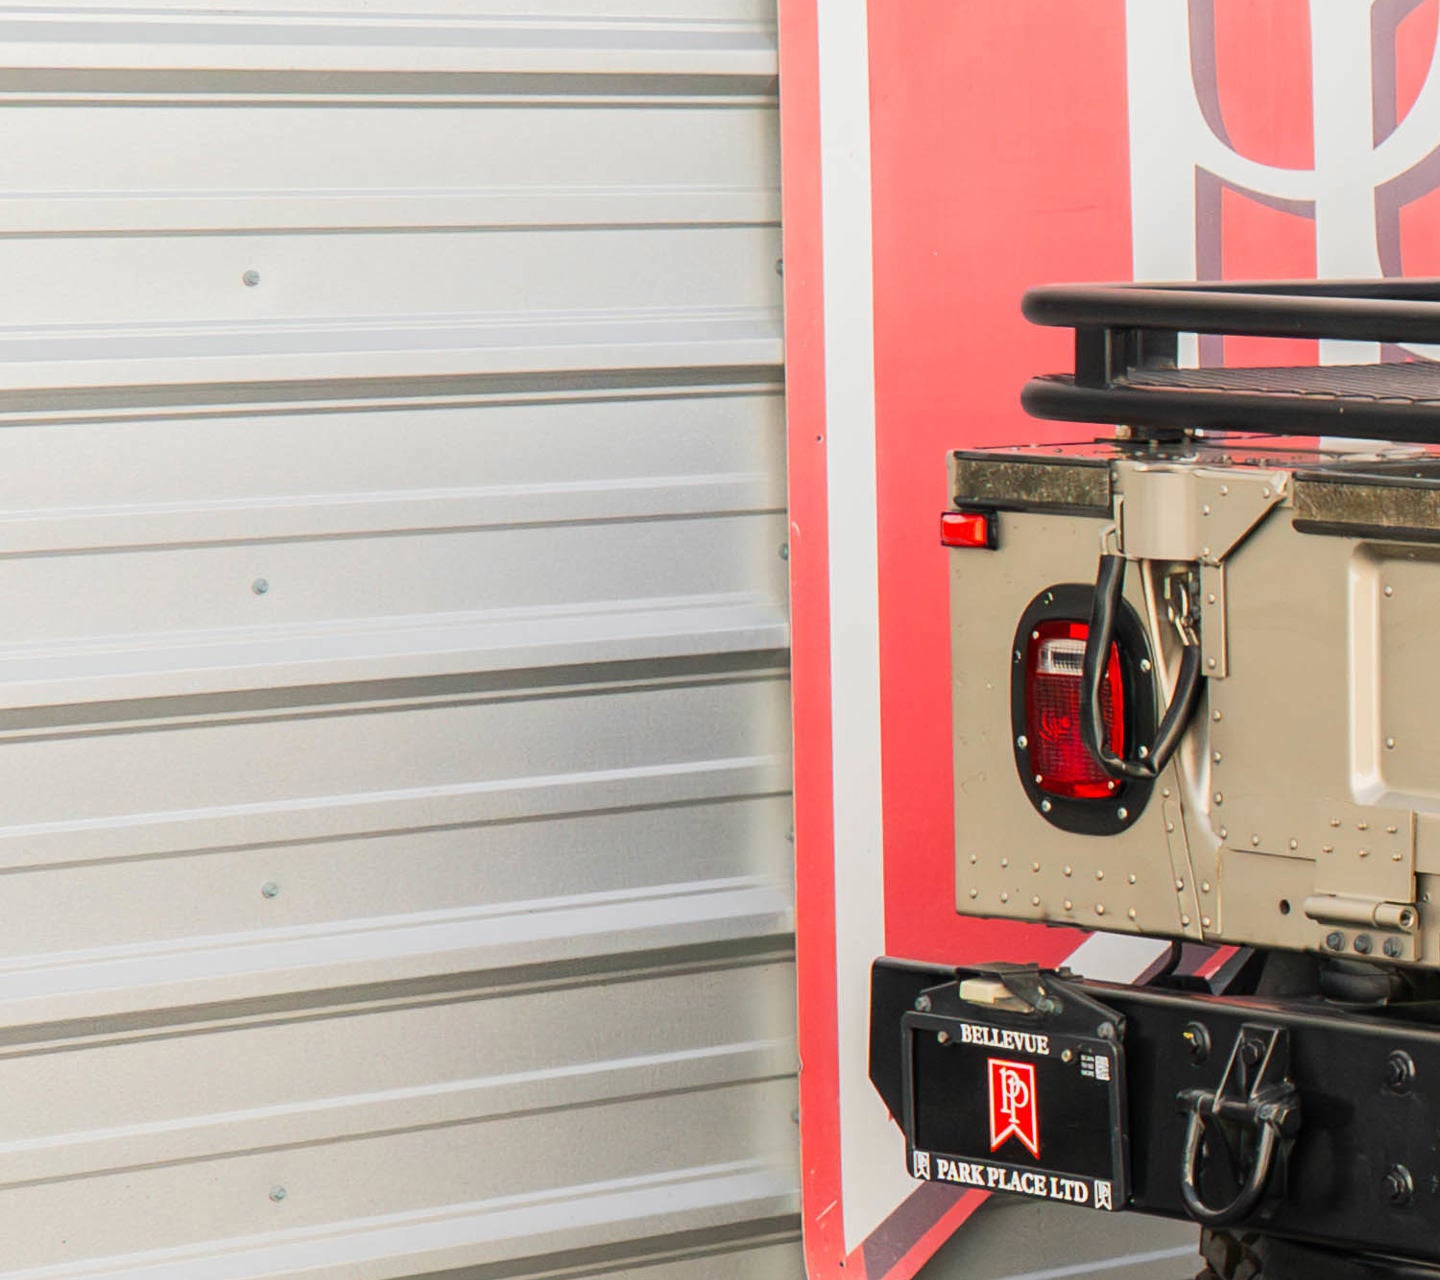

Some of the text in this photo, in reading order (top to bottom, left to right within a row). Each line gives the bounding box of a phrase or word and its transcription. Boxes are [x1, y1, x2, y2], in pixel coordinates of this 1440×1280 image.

[960, 1023, 1050, 1055] BELLEVUE
[937, 1158, 986, 1186] PARK
[987, 1165, 1048, 1197] PLACE
[1050, 1177, 1089, 1203] LTD
